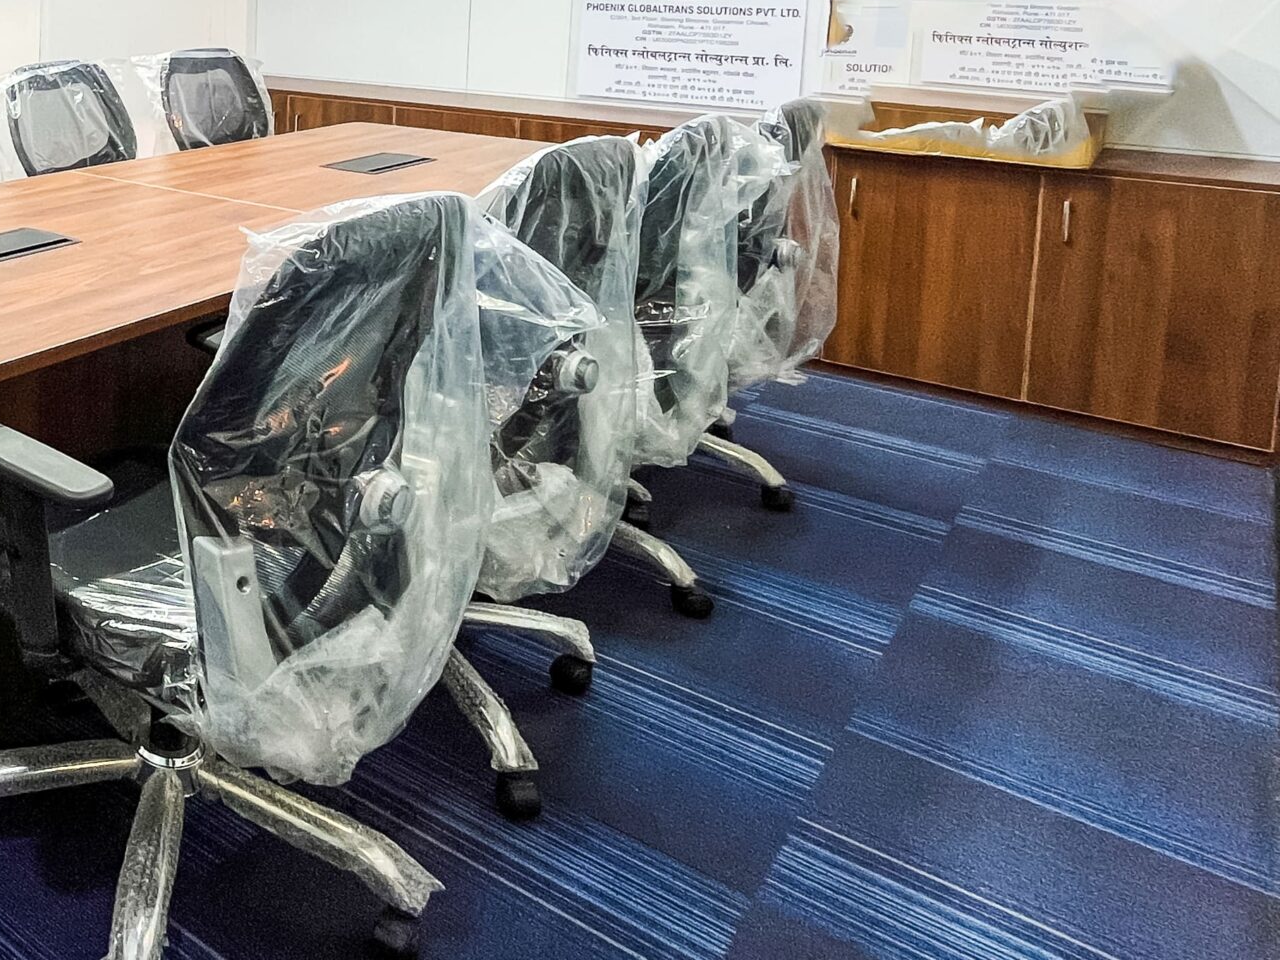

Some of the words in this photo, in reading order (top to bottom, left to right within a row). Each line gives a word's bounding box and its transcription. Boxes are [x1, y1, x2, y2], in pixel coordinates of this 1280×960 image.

[587, 2, 625, 12] PHOENIX
[628, 3, 694, 14] GLOBALTRANS
[696, 5, 753, 17] SOLUTIONS
[780, 8, 802, 18] LTD.
[588, 44, 629, 58] फिनिक्स
[694, 49, 749, 66] सोल्युशन्स
[752, 56, 769, 66] प्रा.
[774, 54, 793, 68] लि.
